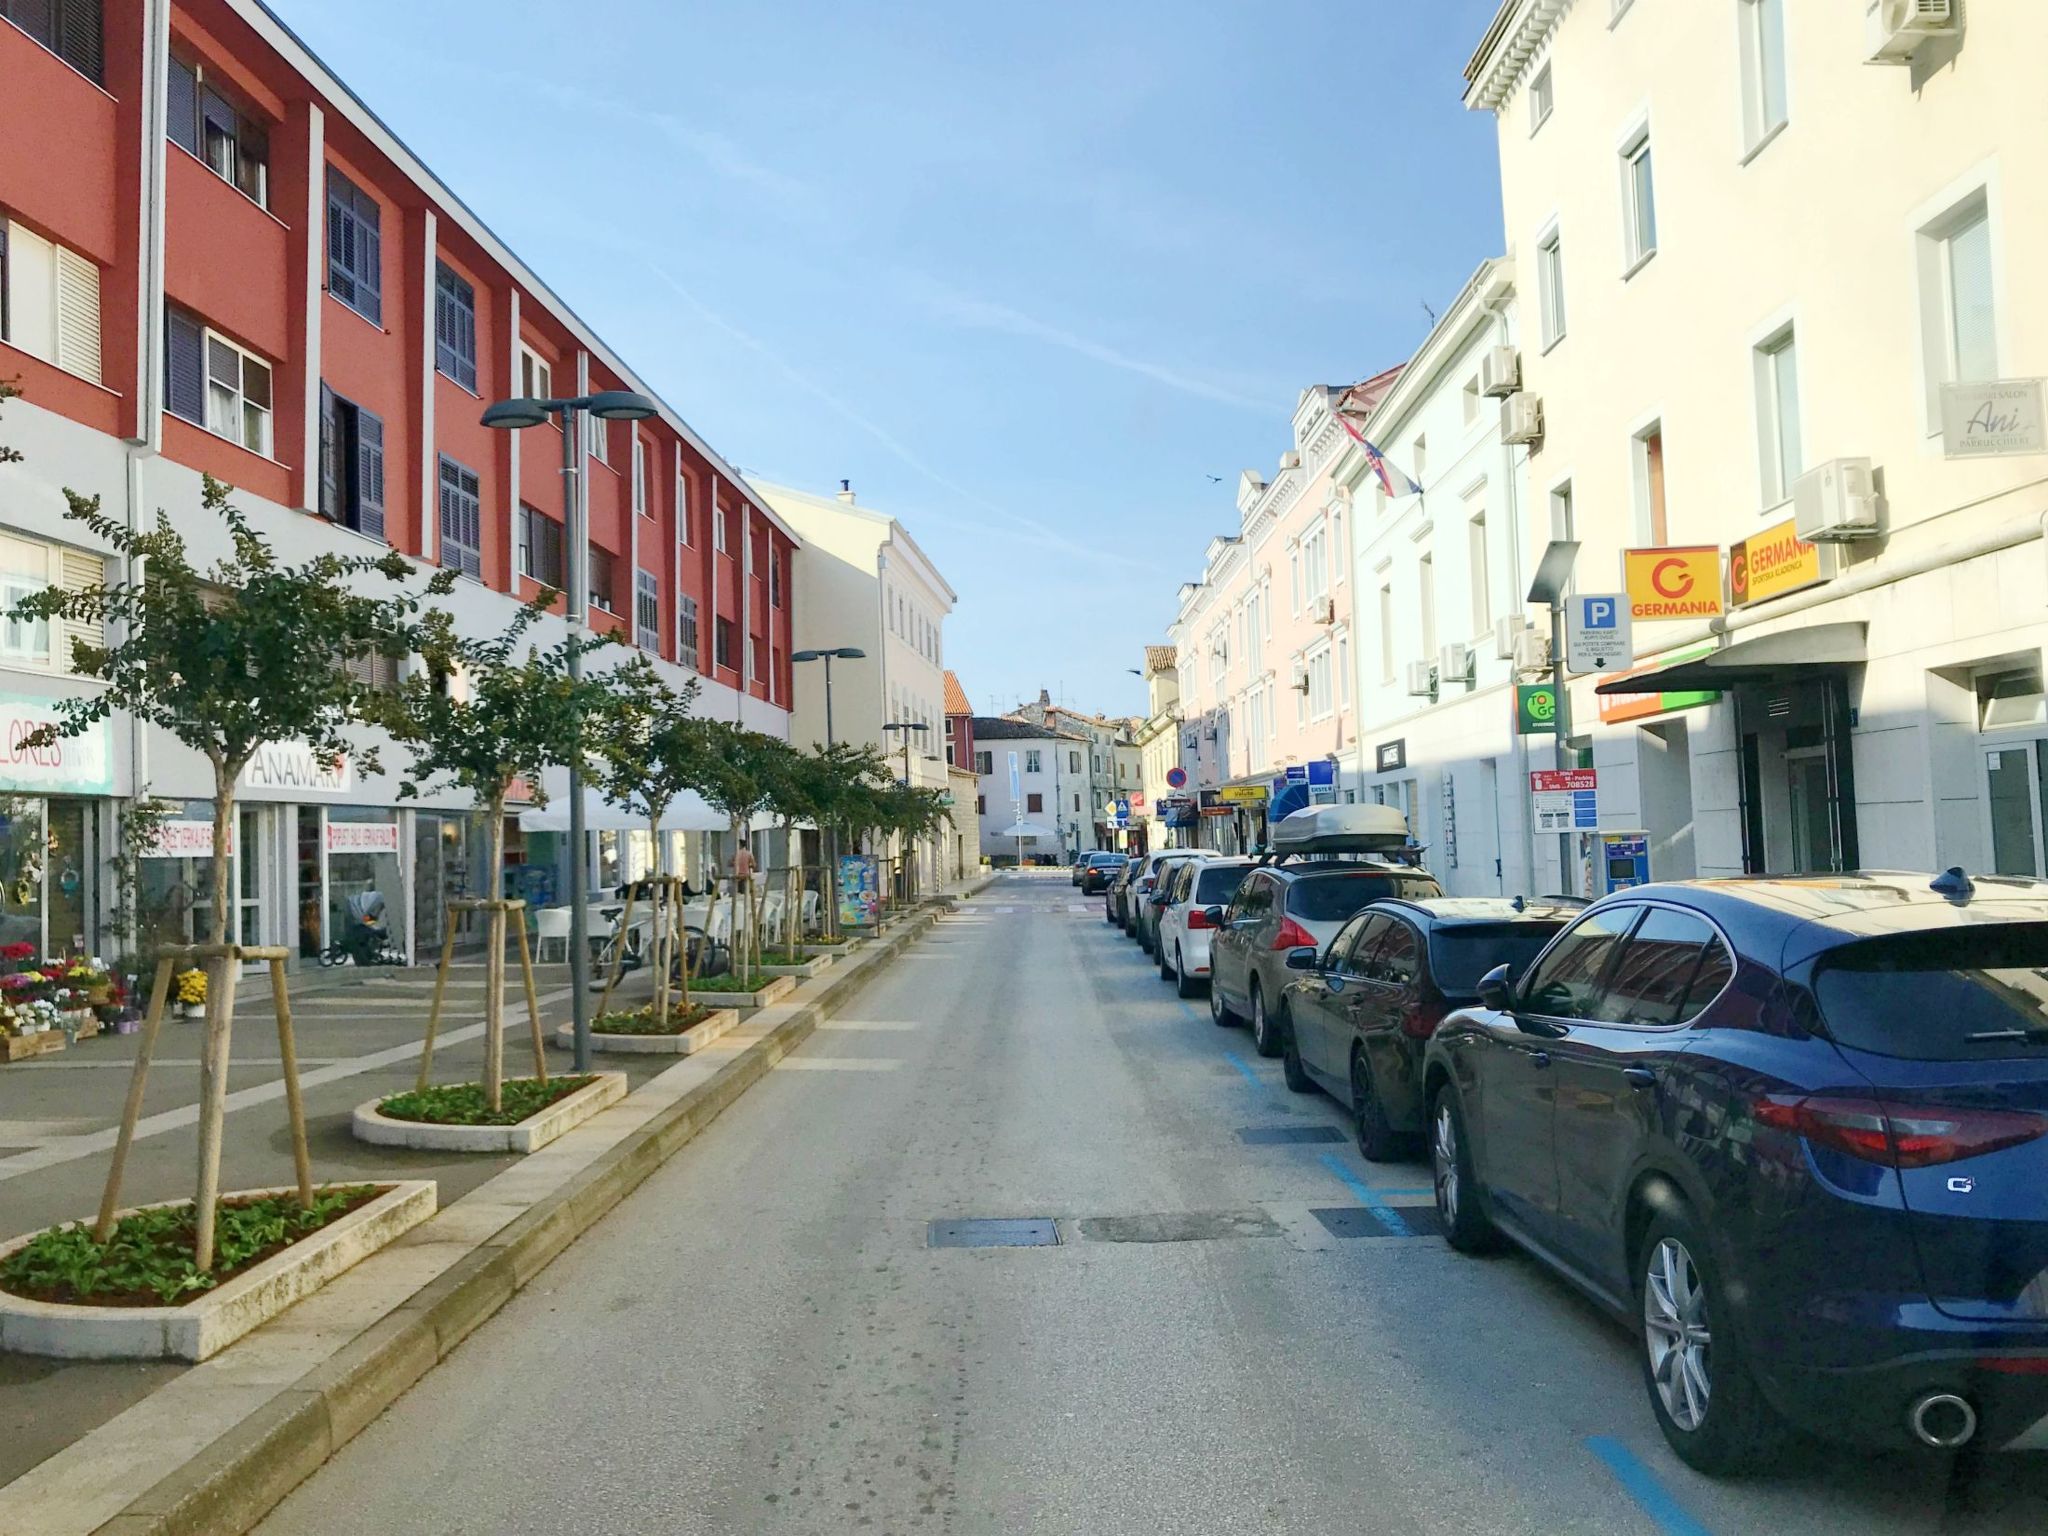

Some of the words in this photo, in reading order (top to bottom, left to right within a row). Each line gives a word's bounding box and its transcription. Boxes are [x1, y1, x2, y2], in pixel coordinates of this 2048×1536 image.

[1967, 400, 2020, 434] Ani
[1592, 602, 1610, 625] P
[1632, 601, 1719, 617] GERMANIA
[1530, 694, 1547, 706] TO
[1566, 780, 1594, 789] 708528
